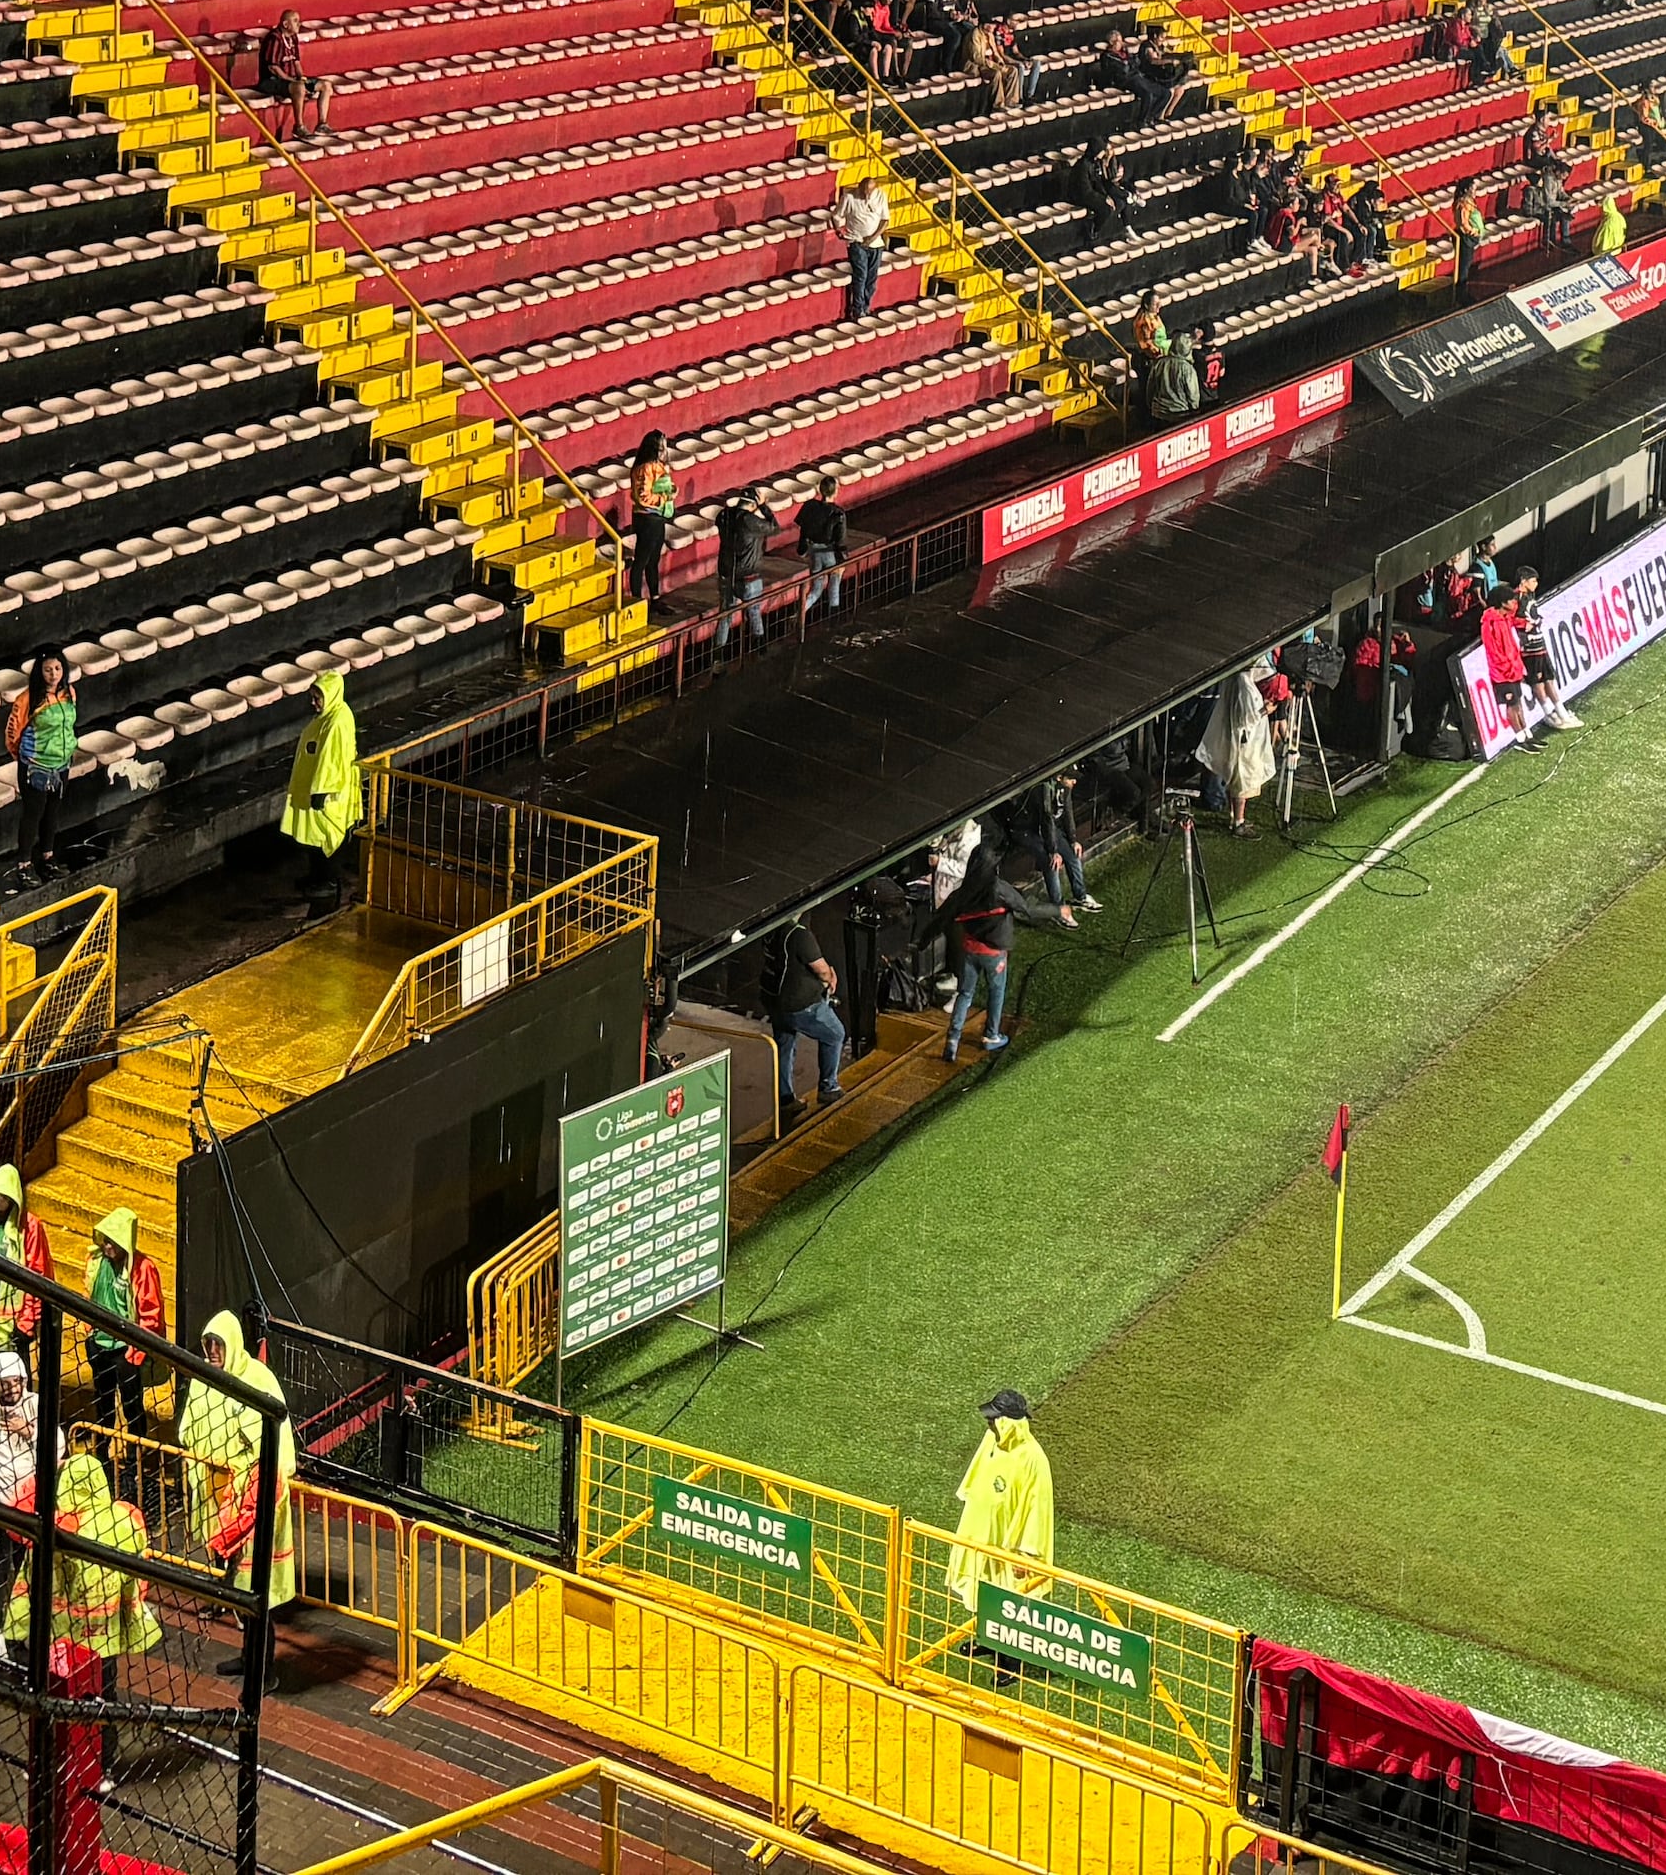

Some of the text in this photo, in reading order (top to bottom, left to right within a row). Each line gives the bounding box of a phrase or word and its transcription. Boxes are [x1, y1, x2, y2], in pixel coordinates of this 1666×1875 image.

[1542, 275, 1601, 309] EMERGENCIAS
[1225, 397, 1276, 441] PEDREGAL
[1157, 424, 1211, 470] PEDREGAL
[1084, 453, 1141, 501] PEDREGAL
[1002, 485, 1066, 536] PEDREGAL
[661, 1511, 801, 1570] EMERGENCIA
[676, 1492, 786, 1541] SALIDA DE
[1001, 1599, 1121, 1657] SALIDA DE
[985, 1619, 1137, 1689] EMERGENCIA
